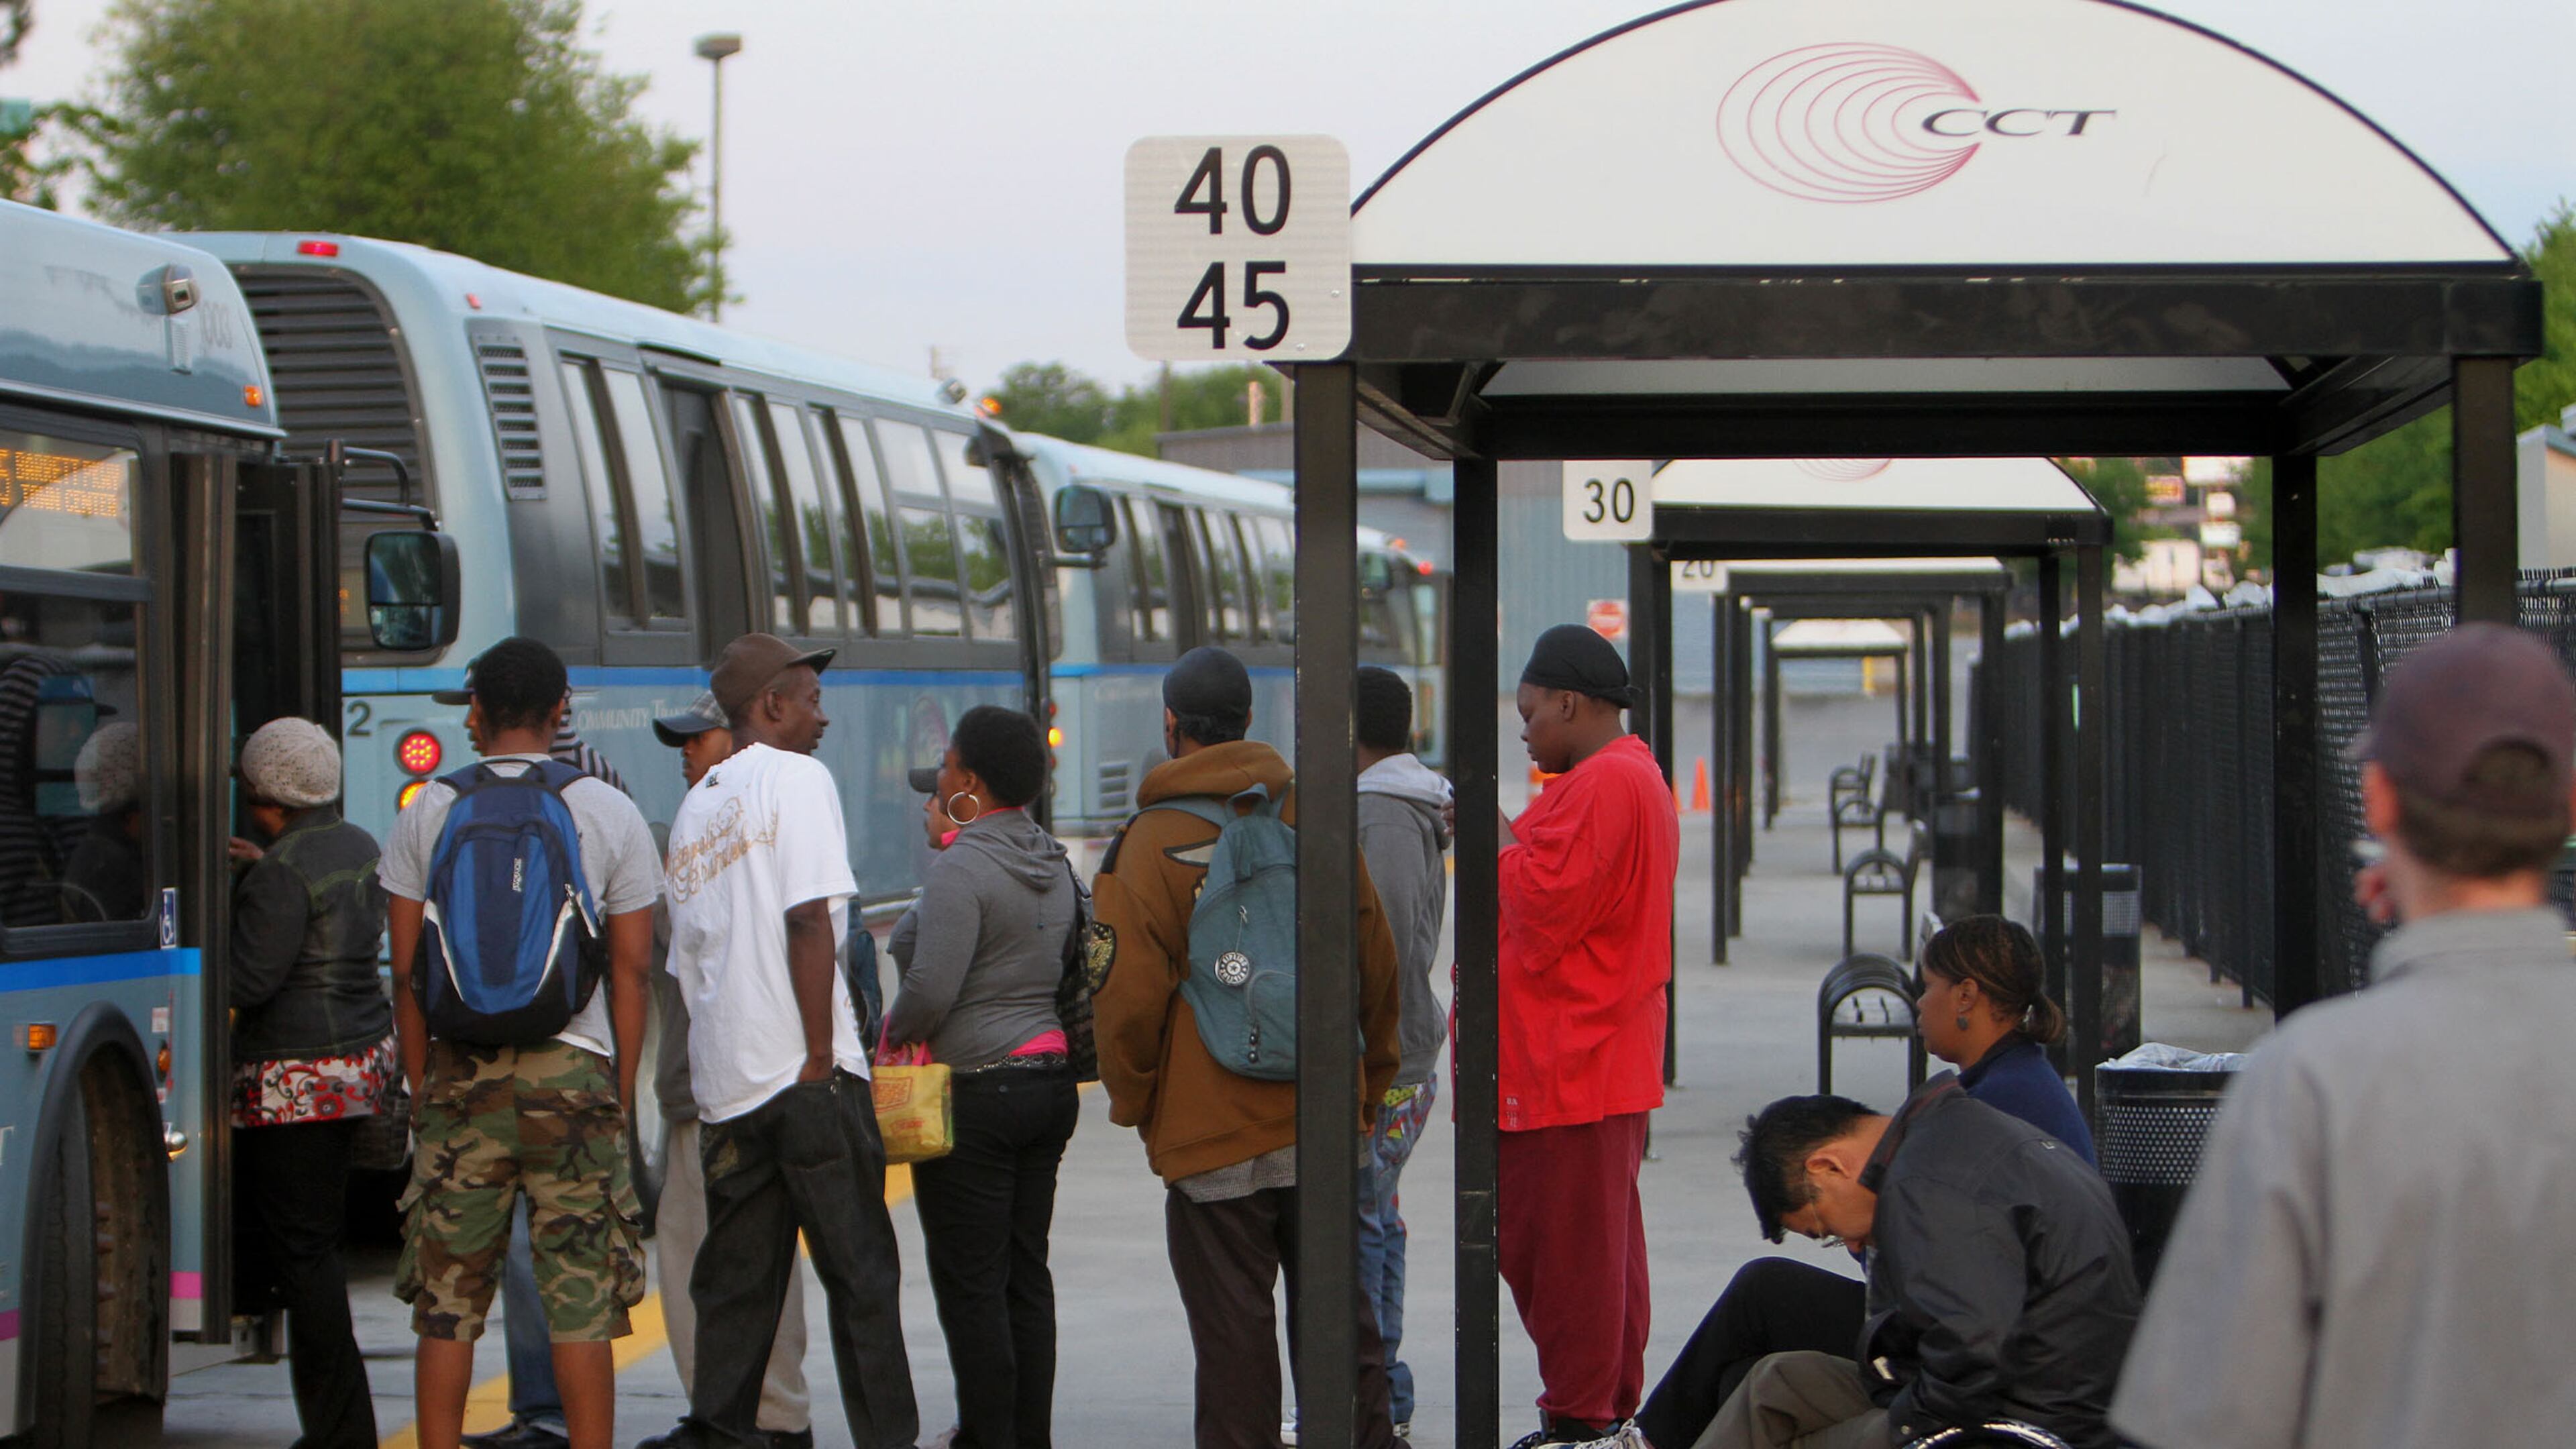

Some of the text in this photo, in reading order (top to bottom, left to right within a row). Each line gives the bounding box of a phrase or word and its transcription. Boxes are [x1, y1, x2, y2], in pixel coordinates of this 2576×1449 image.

[1922, 108, 2117, 137] CCT
[1173, 144, 1292, 235] 40
[1177, 260, 1290, 350] 45
[1582, 477, 1635, 524] 30
